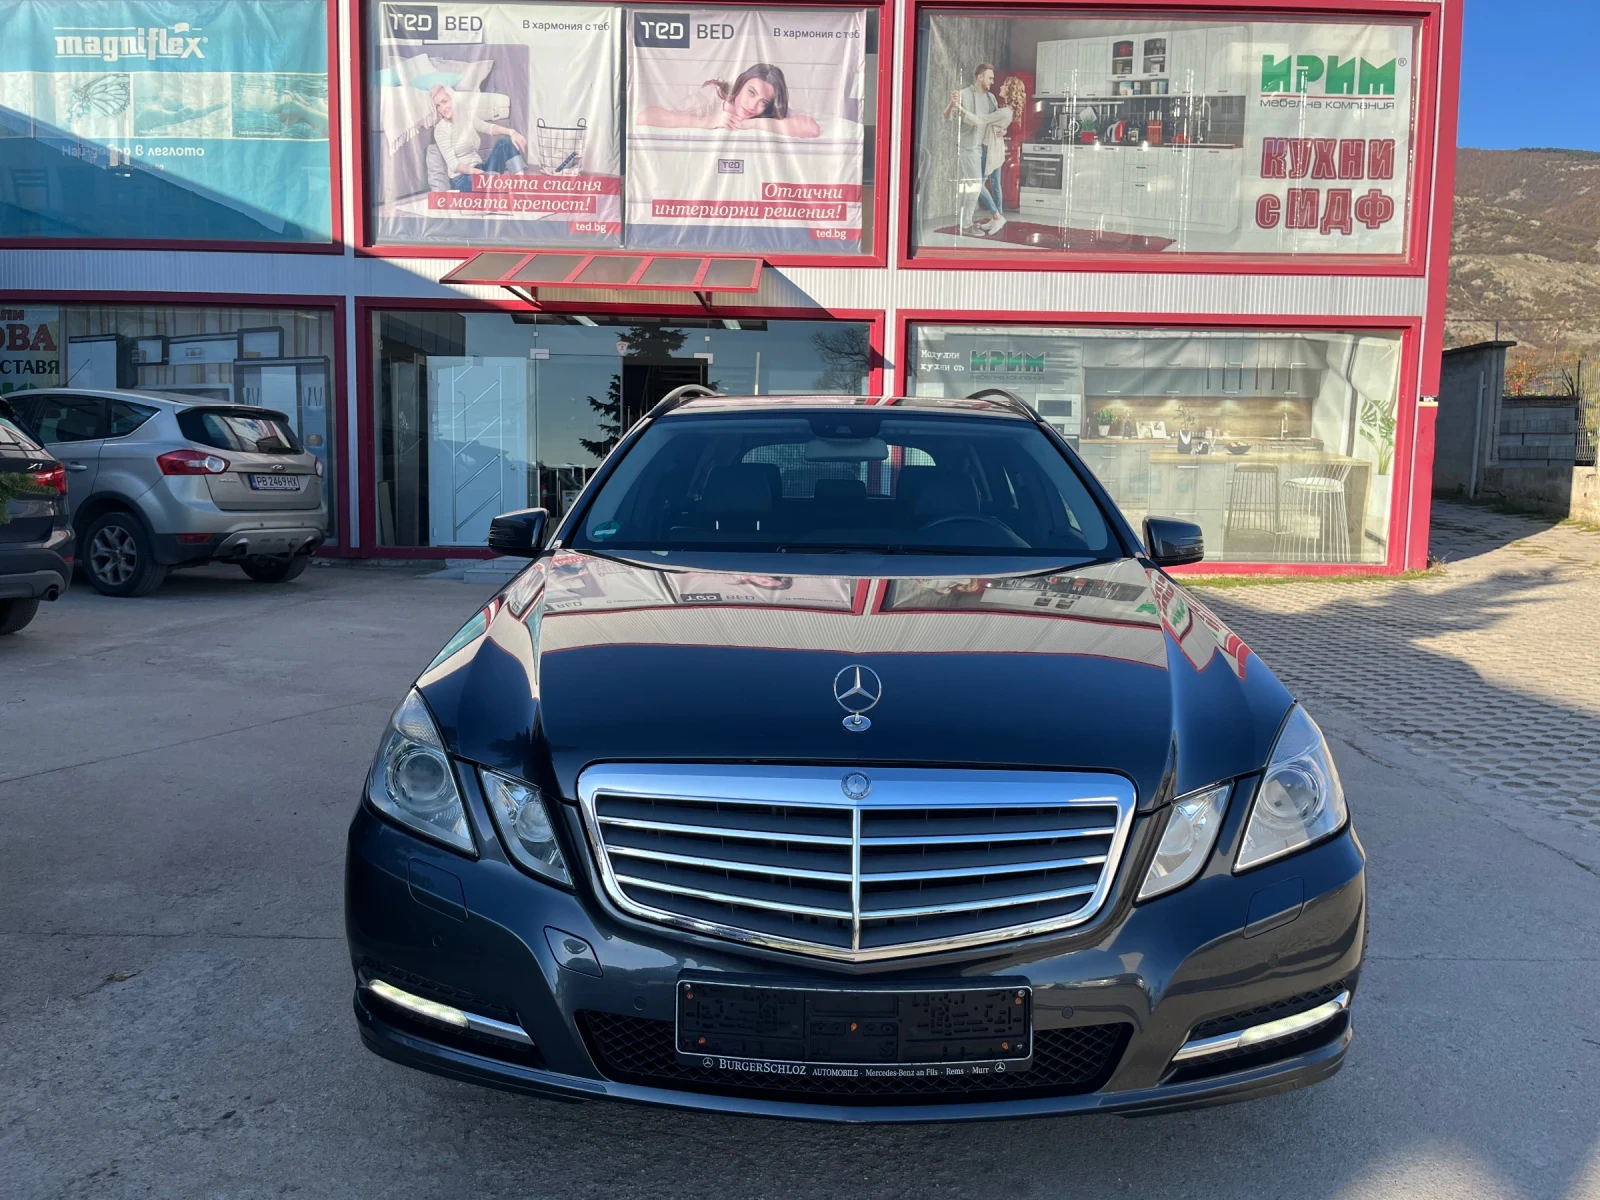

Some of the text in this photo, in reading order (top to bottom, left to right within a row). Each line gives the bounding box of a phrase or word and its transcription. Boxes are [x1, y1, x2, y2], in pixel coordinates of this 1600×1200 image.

[445, 15, 483, 32] BED
[522, 19, 610, 32] В хармония с теб
[696, 23, 735, 40] BED
[773, 27, 781, 37] В
[783, 30, 834, 40] хармония
[843, 30, 860, 38] теб
[55, 24, 206, 61] magniflex
[1260, 54, 1396, 95] ИРИМ
[1260, 99, 1395, 110] мебелна компания
[135, 144, 144, 157] в
[147, 146, 205, 157] леглото
[1260, 136, 1396, 180] КУХНИ
[477, 174, 602, 192] Моята спалня
[764, 183, 843, 199] Отлични
[437, 196, 591, 213] е моята крепост!
[655, 202, 841, 220] интериорни решения!
[575, 222, 607, 234] ted.bg
[816, 229, 847, 240] ted.bg
[719, 1058, 807, 1075] BURGERSCHLOZ
[812, 1067, 859, 1077] AUTOMOBILE
[865, 1068, 915, 1077] Mercedes-Benz
[926, 1067, 938, 1076] Fils
[946, 1067, 964, 1076] Rems
[972, 1065, 989, 1075] Murr
